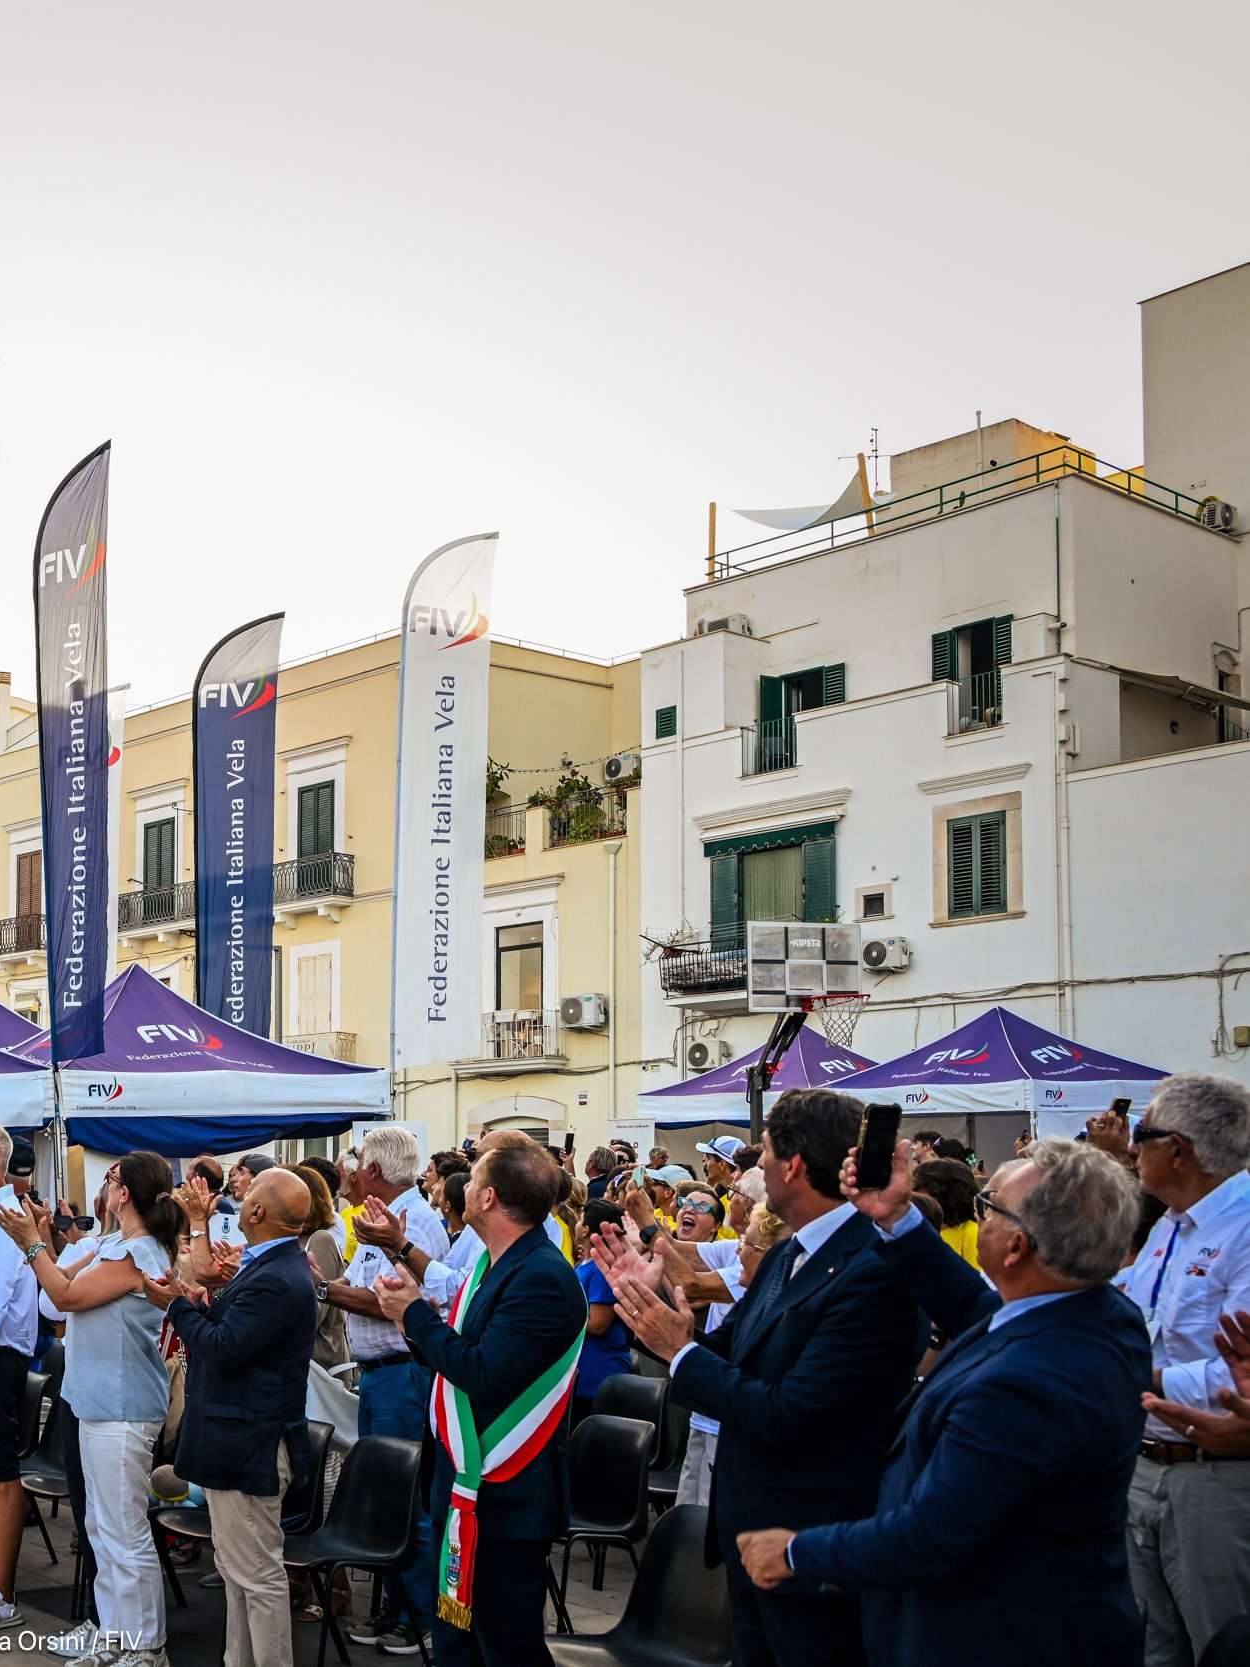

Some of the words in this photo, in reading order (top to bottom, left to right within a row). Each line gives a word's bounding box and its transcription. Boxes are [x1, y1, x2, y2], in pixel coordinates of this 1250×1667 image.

[38, 543, 87, 588] FIV
[408, 604, 468, 638] FIV
[64, 621, 82, 688] Vela
[199, 682, 255, 709] FIV
[434, 674, 456, 733] Vela
[65, 699, 86, 816] Italiana
[226, 738, 245, 791] Vela
[431, 743, 455, 846] Italiana
[226, 797, 245, 888] Italiana
[63, 827, 87, 1010] Federazione
[427, 856, 451, 1024] Federazione
[226, 894, 245, 1026] ederazione
[136, 1024, 199, 1043] FIV
[126, 1050, 206, 1061] Federazione
[820, 1059, 857, 1074] FIV
[923, 1048, 976, 1065] FIV
[1030, 1045, 1073, 1064] FIV
[88, 1083, 113, 1097] FIV
[905, 1093, 923, 1103] FIV
[1045, 1089, 1059, 1100] FIV
